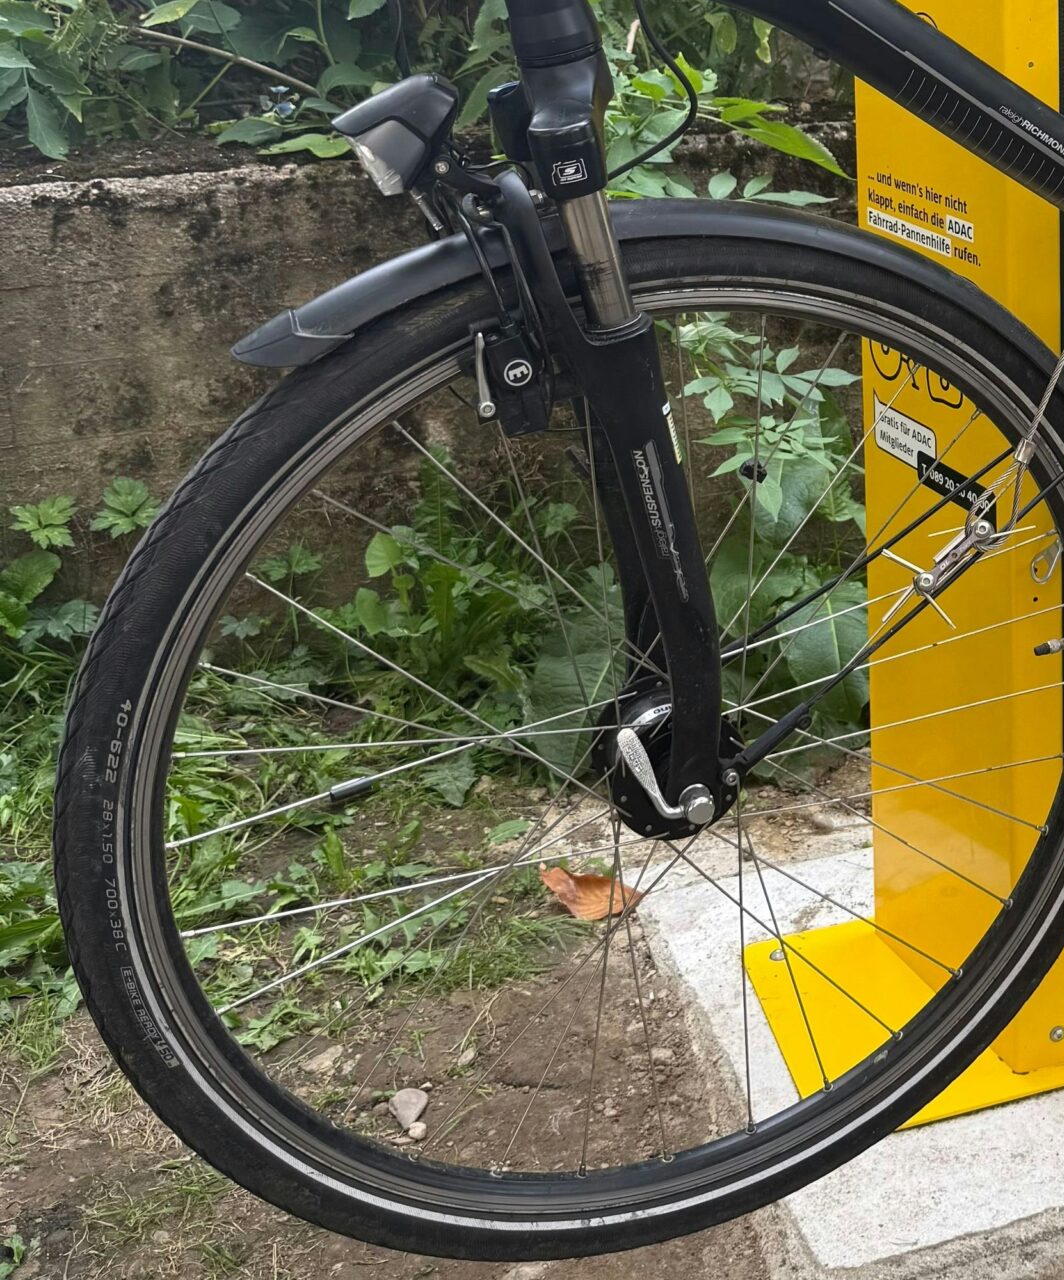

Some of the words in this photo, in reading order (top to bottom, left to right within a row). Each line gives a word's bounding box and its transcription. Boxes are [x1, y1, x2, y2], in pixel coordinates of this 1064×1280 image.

[876, 171, 892, 187] und
[925, 186, 942, 204] hier
[944, 195, 968, 214] nicht
[868, 210, 951, 255] Fahrrad-Pannenhilfe
[953, 246, 981, 267] rufen.
[898, 201, 929, 223] einfach
[930, 212, 945, 229] die
[947, 219, 973, 240] ADAC
[880, 429, 914, 457] Mitglieder
[900, 421, 911, 436] für
[911, 428, 932, 449] ADAC
[105, 699, 132, 784] 40-622
[123, 968, 142, 1006] E-BIKE
